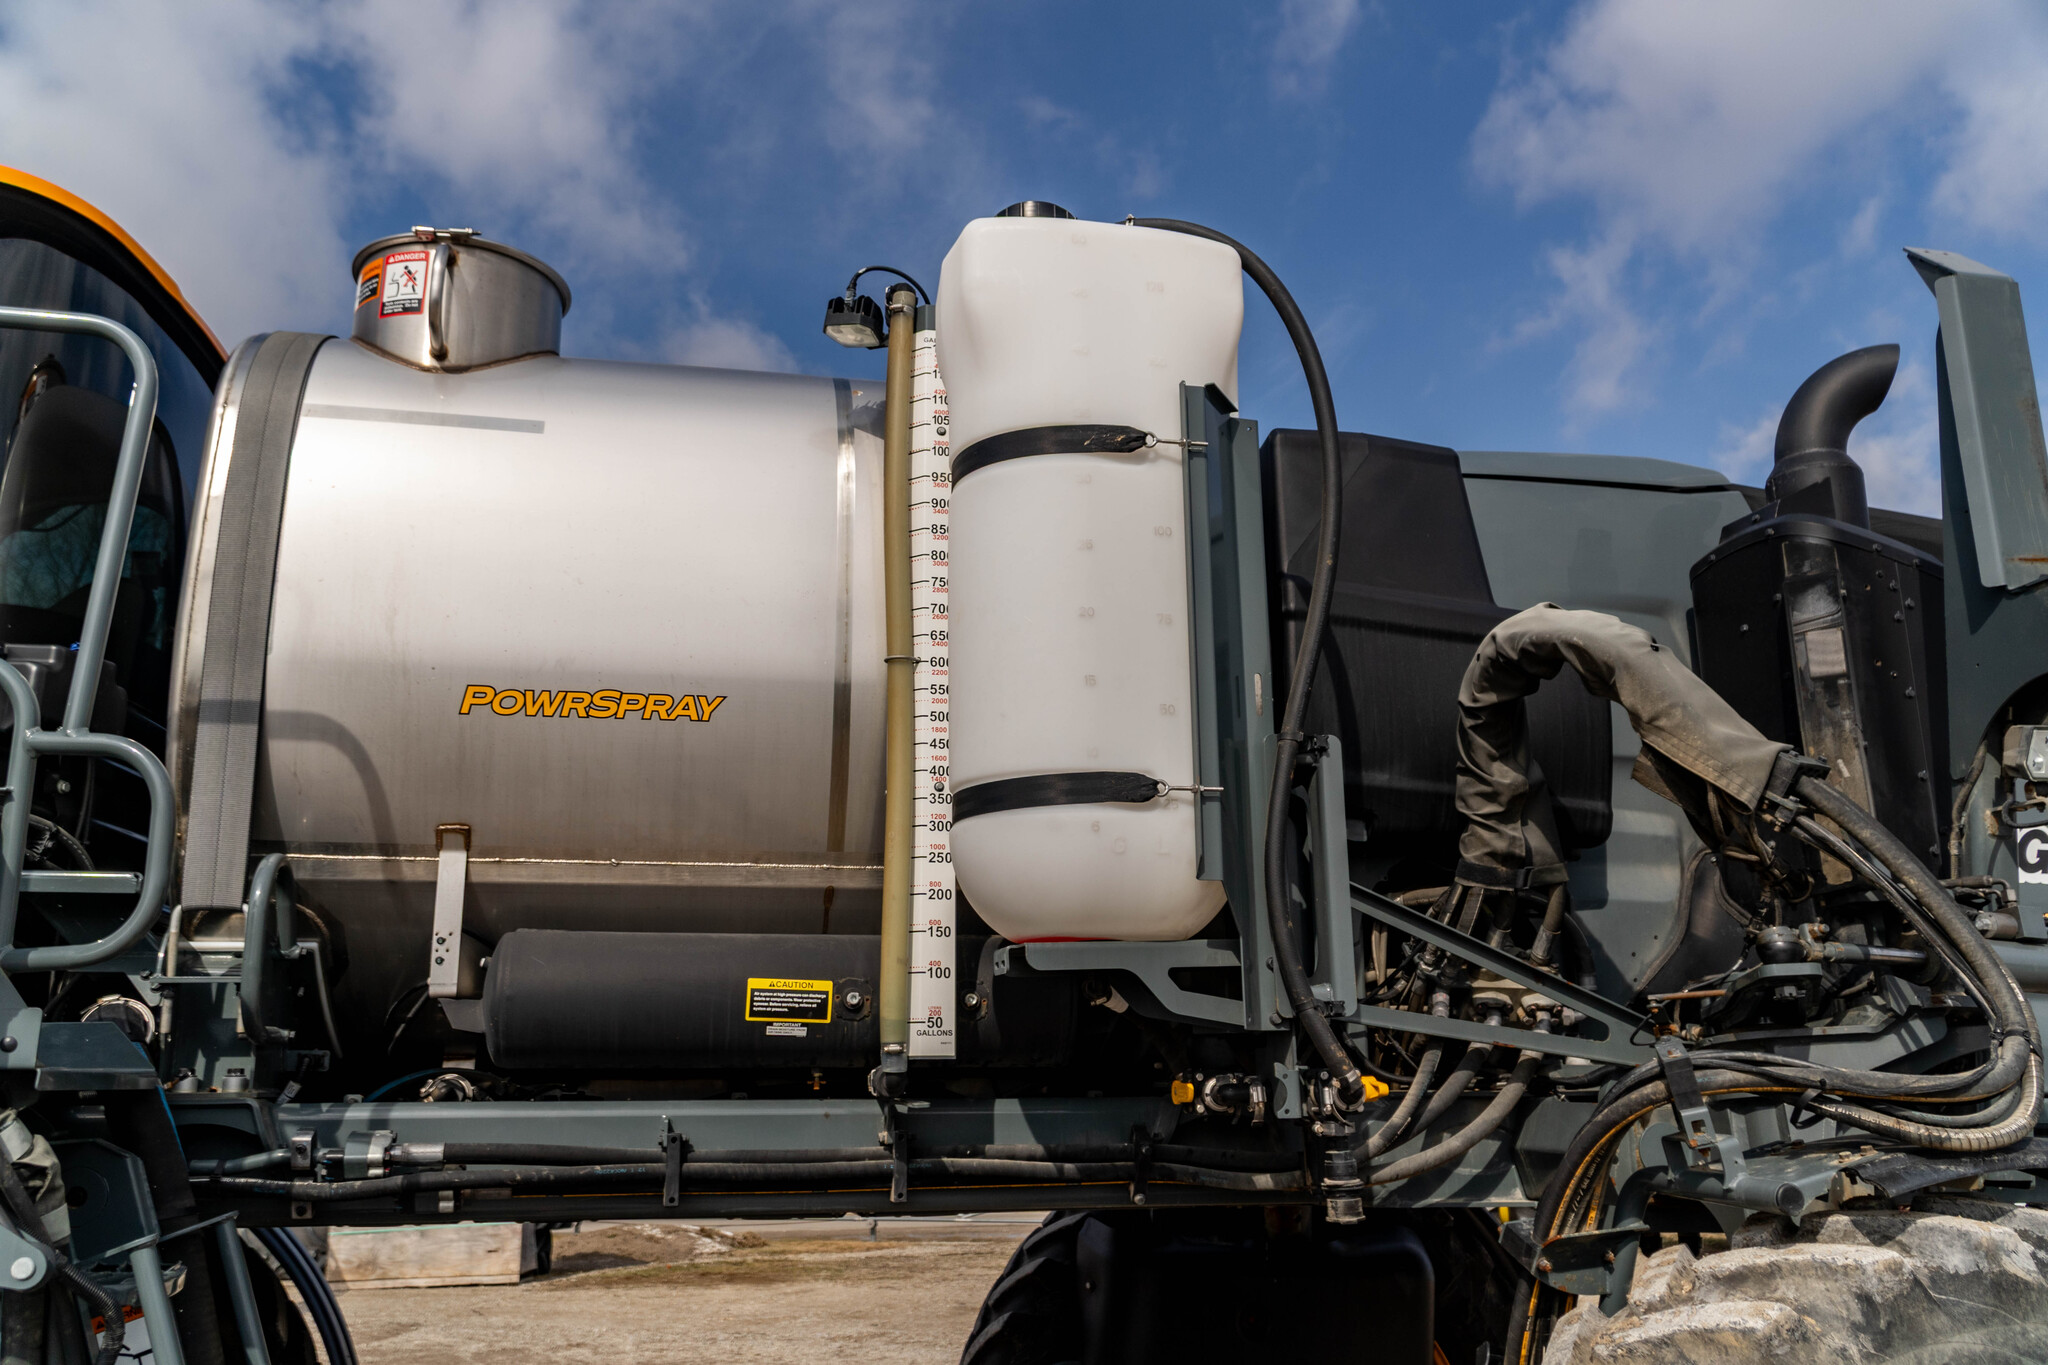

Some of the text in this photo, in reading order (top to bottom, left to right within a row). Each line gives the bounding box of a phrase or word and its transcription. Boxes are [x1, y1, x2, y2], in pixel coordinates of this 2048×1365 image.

[395, 252, 425, 261] DANGER
[932, 415, 950, 425] 105
[932, 446, 950, 456] 100
[931, 472, 953, 483] 950
[931, 524, 949, 534] 85
[931, 550, 948, 560] 80
[931, 576, 948, 587] 75
[930, 603, 948, 614] 70
[930, 630, 949, 641] 65
[459, 685, 727, 721] POWRSPRAY
[929, 793, 953, 804] 350
[929, 821, 952, 832] 300
[928, 852, 952, 863] 250
[928, 888, 952, 900] 200
[927, 926, 951, 937] 150
[927, 967, 951, 979] 100
[927, 1016, 943, 1028] 50
[916, 1029, 953, 1037] GALLONS
[1861, 1115, 1893, 1128] SUCTION
